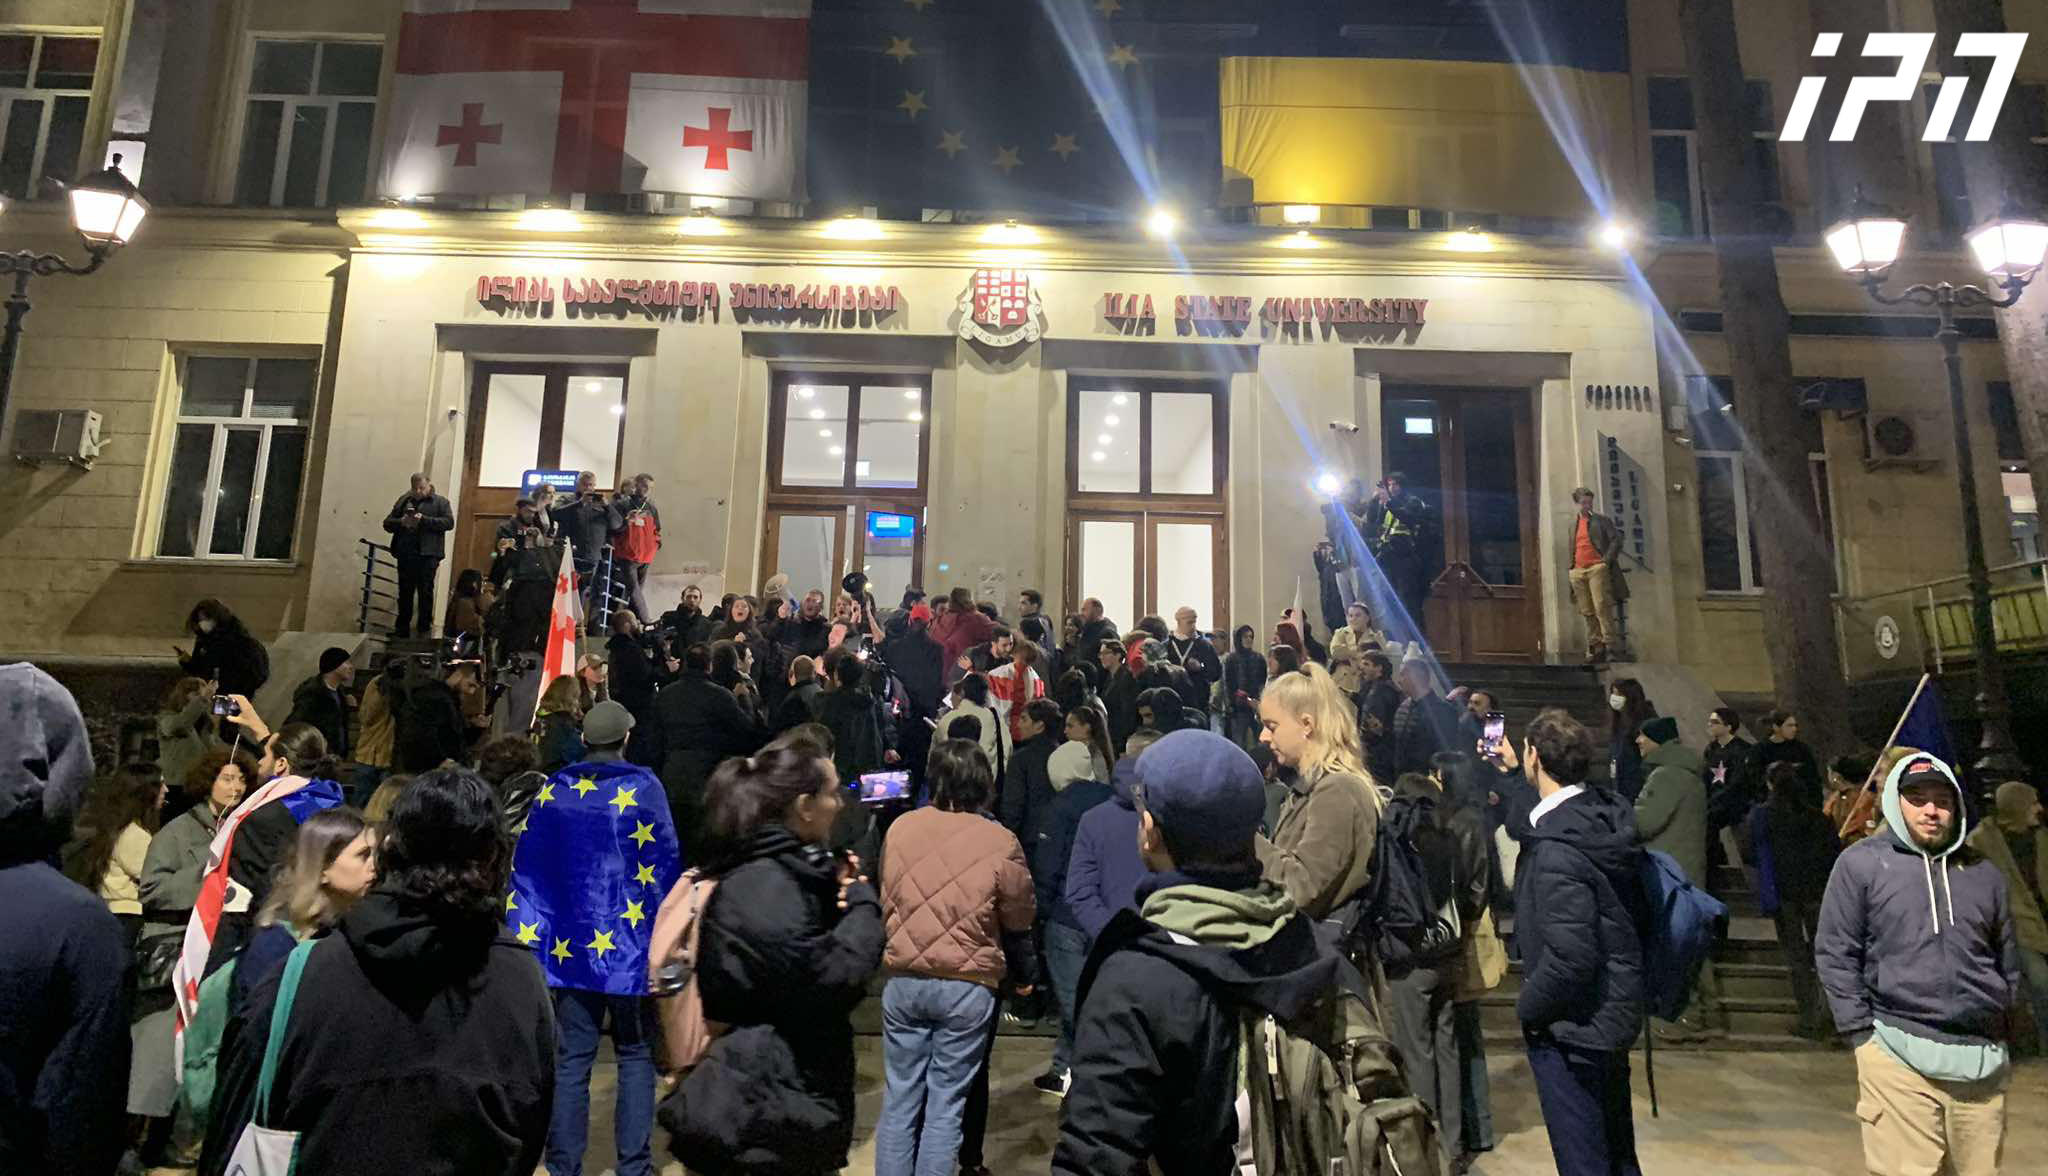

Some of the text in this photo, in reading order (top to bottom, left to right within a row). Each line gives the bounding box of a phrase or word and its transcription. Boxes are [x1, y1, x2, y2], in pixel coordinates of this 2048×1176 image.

[477, 275, 900, 311] ილიას სახელმწიფო უნივერსიტეტი
[1103, 292, 1429, 324] ILIA STATE UNIVERSITY
